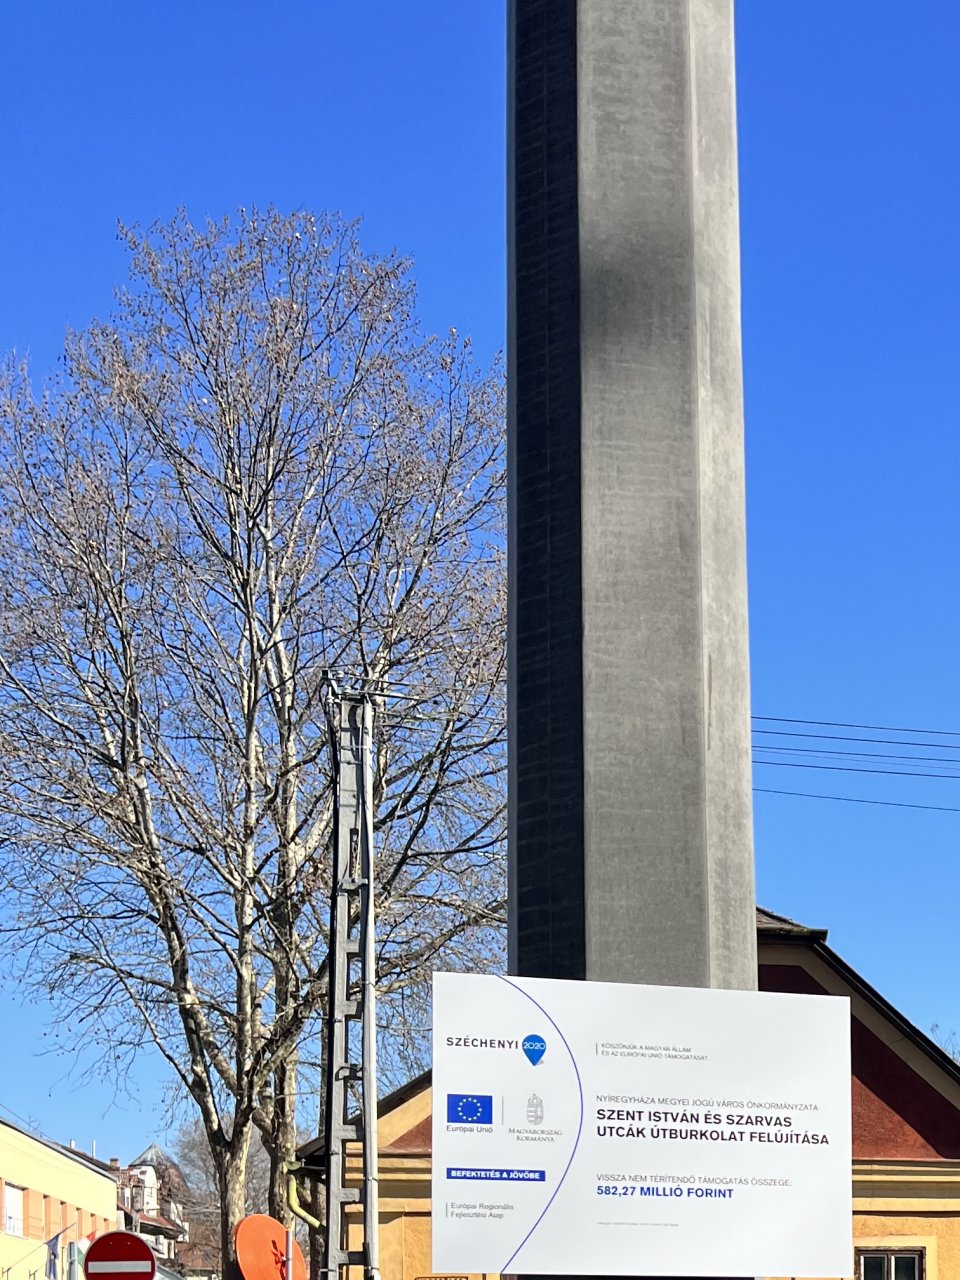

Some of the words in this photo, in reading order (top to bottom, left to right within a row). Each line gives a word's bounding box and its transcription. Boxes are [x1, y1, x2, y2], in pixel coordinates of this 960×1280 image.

[446, 1035, 518, 1050] SZÉCHENYI
[523, 1041, 546, 1050] 2020
[596, 1094, 656, 1104] NYÍREGYHÁZA
[658, 1097, 689, 1106] MEGYEI
[691, 1097, 714, 1107] JOGÚ
[716, 1098, 745, 1108] VÁROS
[746, 1100, 819, 1111] ÖNKORMÁNYZATA
[596, 1109, 644, 1121] SZENT
[648, 1109, 699, 1124] ISTVÁN
[704, 1110, 722, 1125] ÉS
[726, 1114, 792, 1127] SZARVAS
[446, 1125, 475, 1134] Európai
[476, 1125, 493, 1133] Unió
[597, 1123, 646, 1138] UTCÁK
[651, 1124, 745, 1142] ÚTBURKOLAT
[749, 1129, 829, 1145] FELÚJÍTÁSA
[451, 1169, 500, 1178] BEFEKTETÉS
[509, 1170, 540, 1179] JÖVŐBE
[596, 1173, 627, 1182] VISSZA
[628, 1175, 647, 1183] NEM
[649, 1174, 695, 1184] TÉRÍTENDŐ
[698, 1175, 749, 1185] TÁMOGATÁS
[596, 1185, 636, 1198] 582,27
[640, 1184, 683, 1197] MILLIÓ
[687, 1187, 734, 1198] FORINT
[451, 1202, 477, 1211] Európai
[478, 1202, 514, 1211] Regionális
[450, 1211, 486, 1220] Fejlesztési
